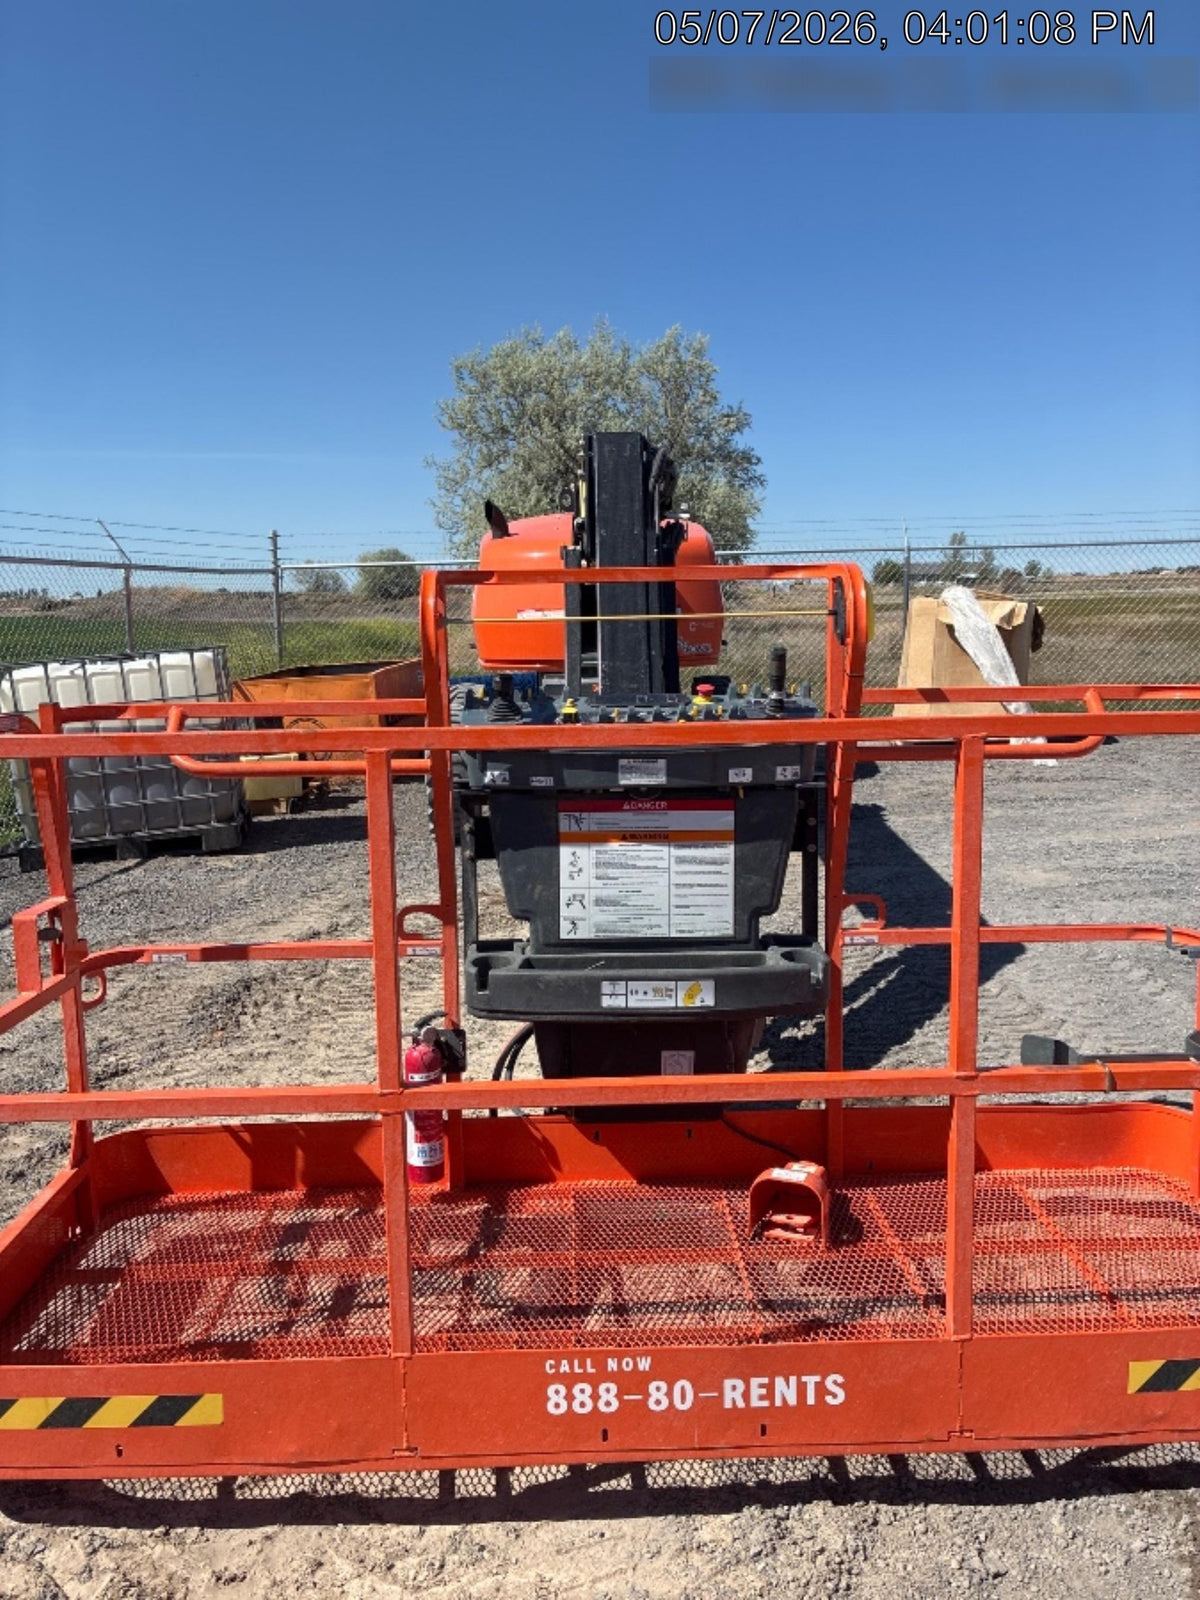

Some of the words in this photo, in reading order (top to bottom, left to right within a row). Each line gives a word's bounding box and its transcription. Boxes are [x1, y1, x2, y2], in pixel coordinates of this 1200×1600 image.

[545, 1359, 596, 1374] CALL
[607, 1357, 652, 1373] NOW
[546, 1374, 846, 1415] 888-80-RENTS
